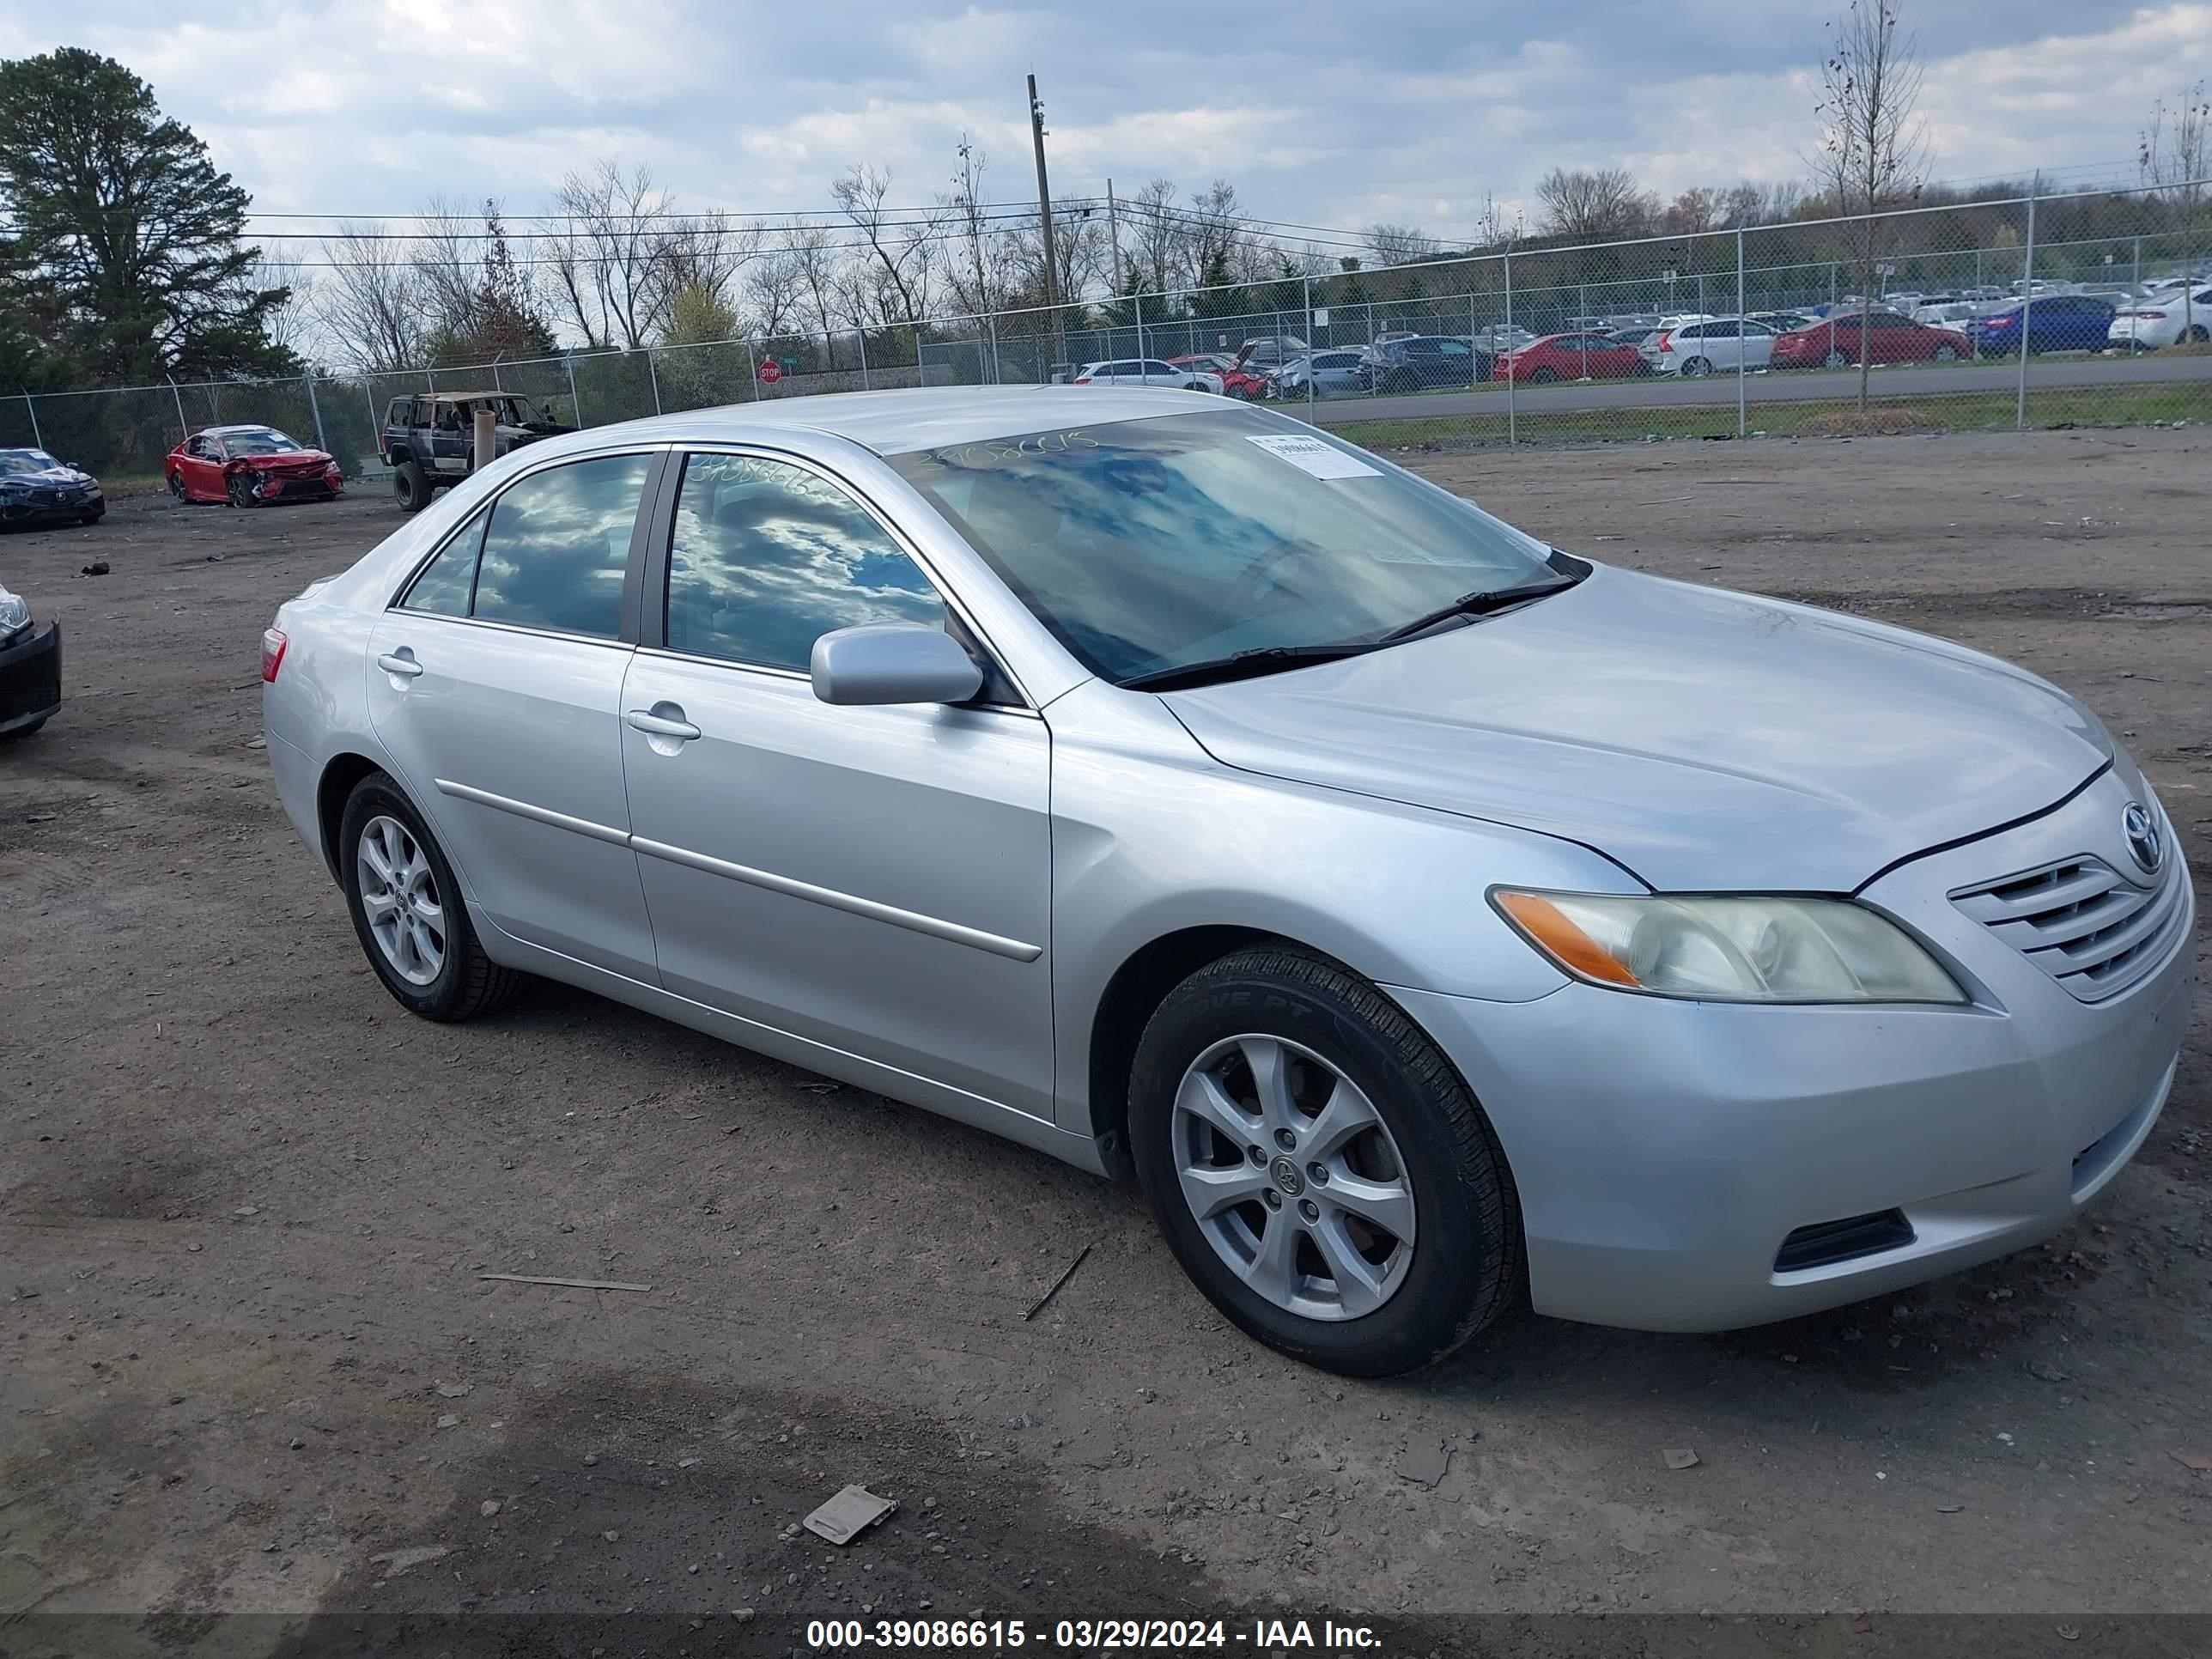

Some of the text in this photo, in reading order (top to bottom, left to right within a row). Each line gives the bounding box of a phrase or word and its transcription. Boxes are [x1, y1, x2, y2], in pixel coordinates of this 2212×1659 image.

[761, 368, 779, 378] STOP
[914, 432, 1098, 471] 39086615
[687, 454, 817, 495] 39086615
